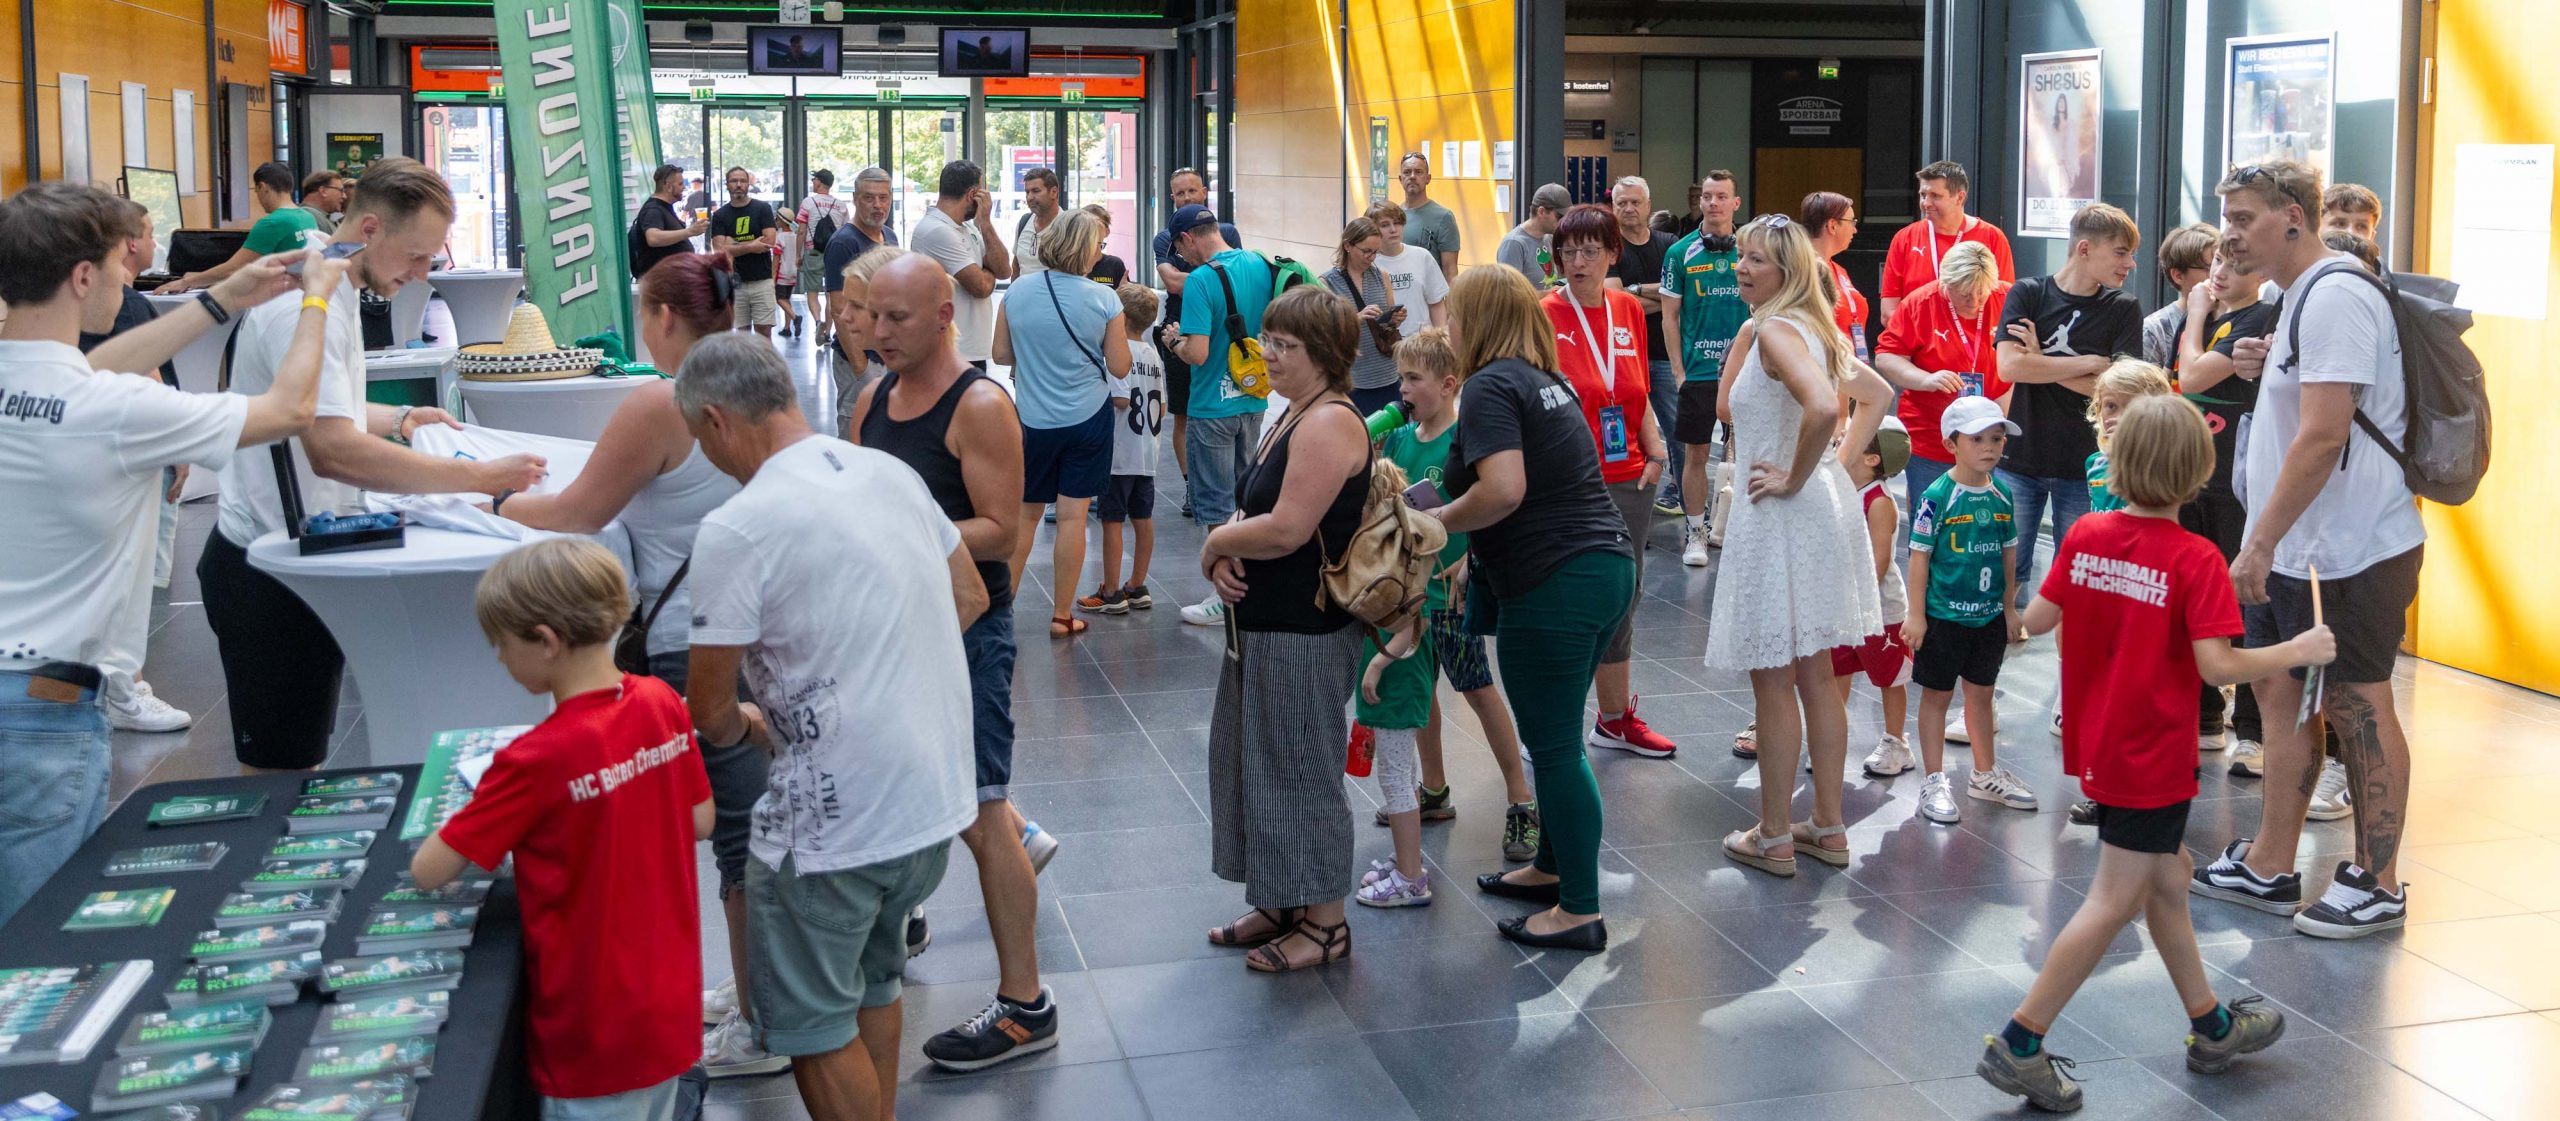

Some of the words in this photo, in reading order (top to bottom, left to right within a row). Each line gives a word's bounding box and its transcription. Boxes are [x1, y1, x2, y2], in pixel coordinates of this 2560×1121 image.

[1573, 82, 1609, 90] kostenfrei
[1782, 111, 1838, 119] SPORTSBAR
[1796, 100, 1825, 108] ARENA
[1707, 285, 1740, 298] Leipzig
[1694, 339, 1732, 349] schnell
[1539, 387, 1557, 410] SC
[1128, 387, 1162, 436] 80
[329, 521, 356, 531] PARIS
[1979, 567, 1992, 592] 8
[2071, 552, 2169, 589] #HANDBALL
[2069, 566, 2168, 608] #inCHEMNITZ
[567, 773, 600, 803] HC
[820, 772, 840, 819] ITALY
